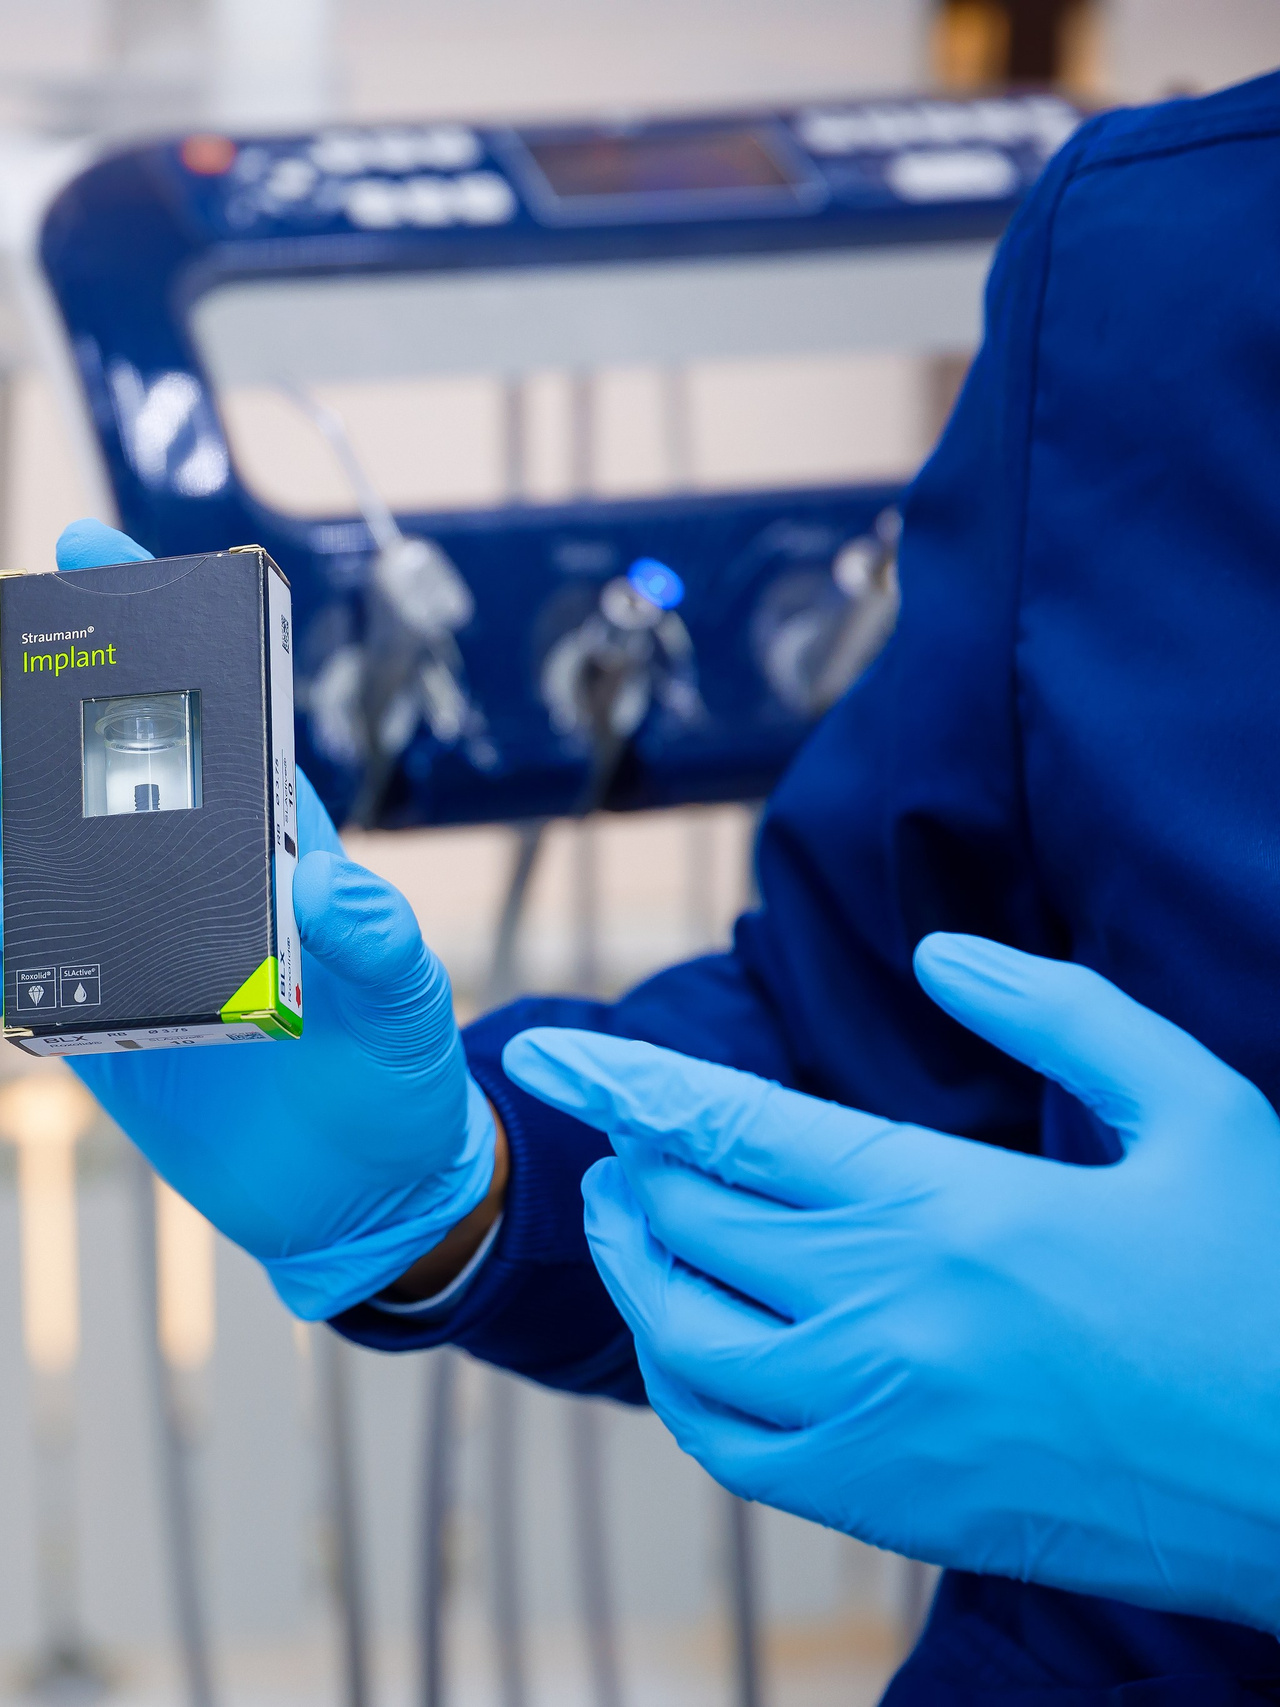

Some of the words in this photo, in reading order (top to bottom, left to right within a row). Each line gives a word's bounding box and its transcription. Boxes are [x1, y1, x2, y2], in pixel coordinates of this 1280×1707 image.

[21, 625, 95, 645] Straumann®
[23, 643, 117, 677] Implant
[288, 782, 293, 808] 10
[43, 1035, 88, 1044] BLX
